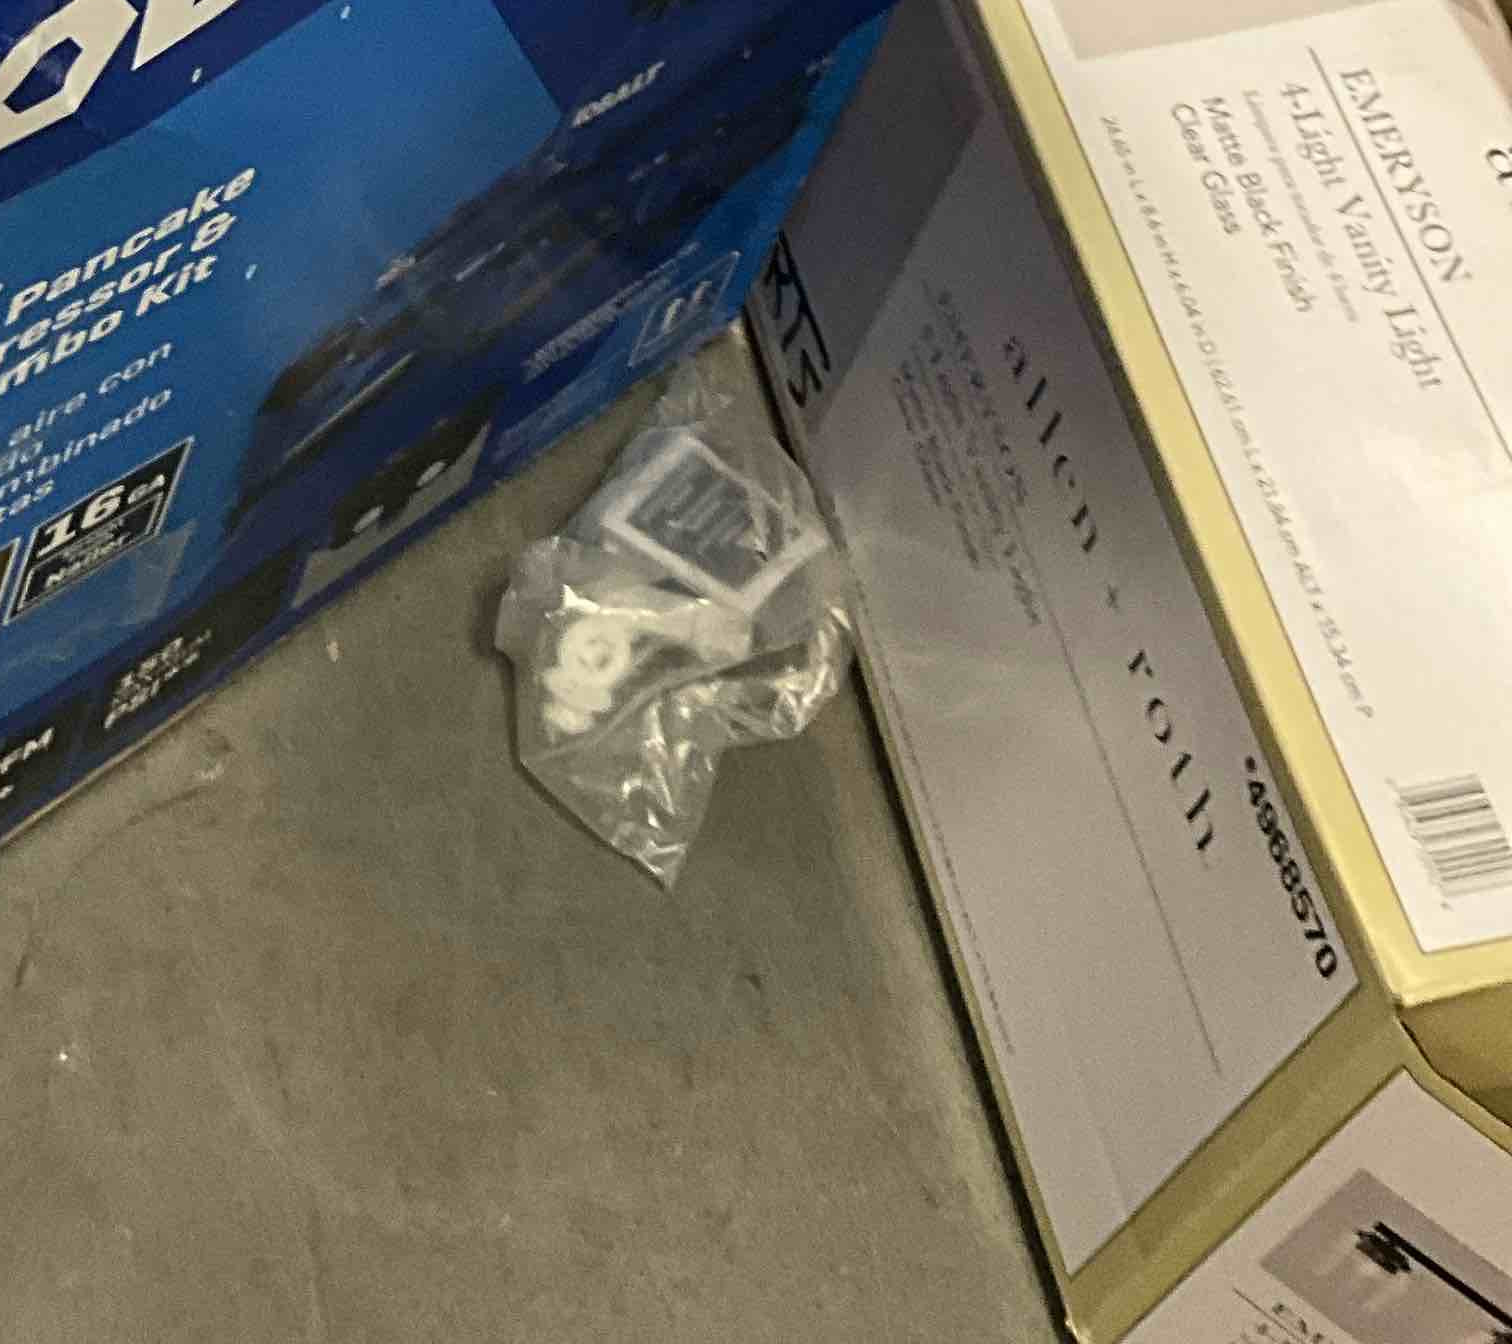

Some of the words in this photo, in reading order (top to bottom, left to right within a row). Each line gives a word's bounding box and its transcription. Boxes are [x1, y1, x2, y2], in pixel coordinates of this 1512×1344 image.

[189, 212, 238, 254] &
[1170, 101, 1210, 169] Clear
[1199, 172, 1242, 237] Glass
[1199, 94, 1246, 169] Matte
[1236, 169, 1278, 237] Black
[1267, 238, 1314, 314] Finish
[1278, 80, 1348, 191] 4-Light
[1336, 193, 1398, 299] Vanity
[1383, 305, 1445, 393] Light
[1341, 65, 1474, 287] EMERYSON
[3, 167, 256, 325] Pancake
[136, 253, 219, 318] Kit
[96, 342, 173, 397] con
[1002, 334, 1098, 553] allen
[35, 484, 119, 558] 16
